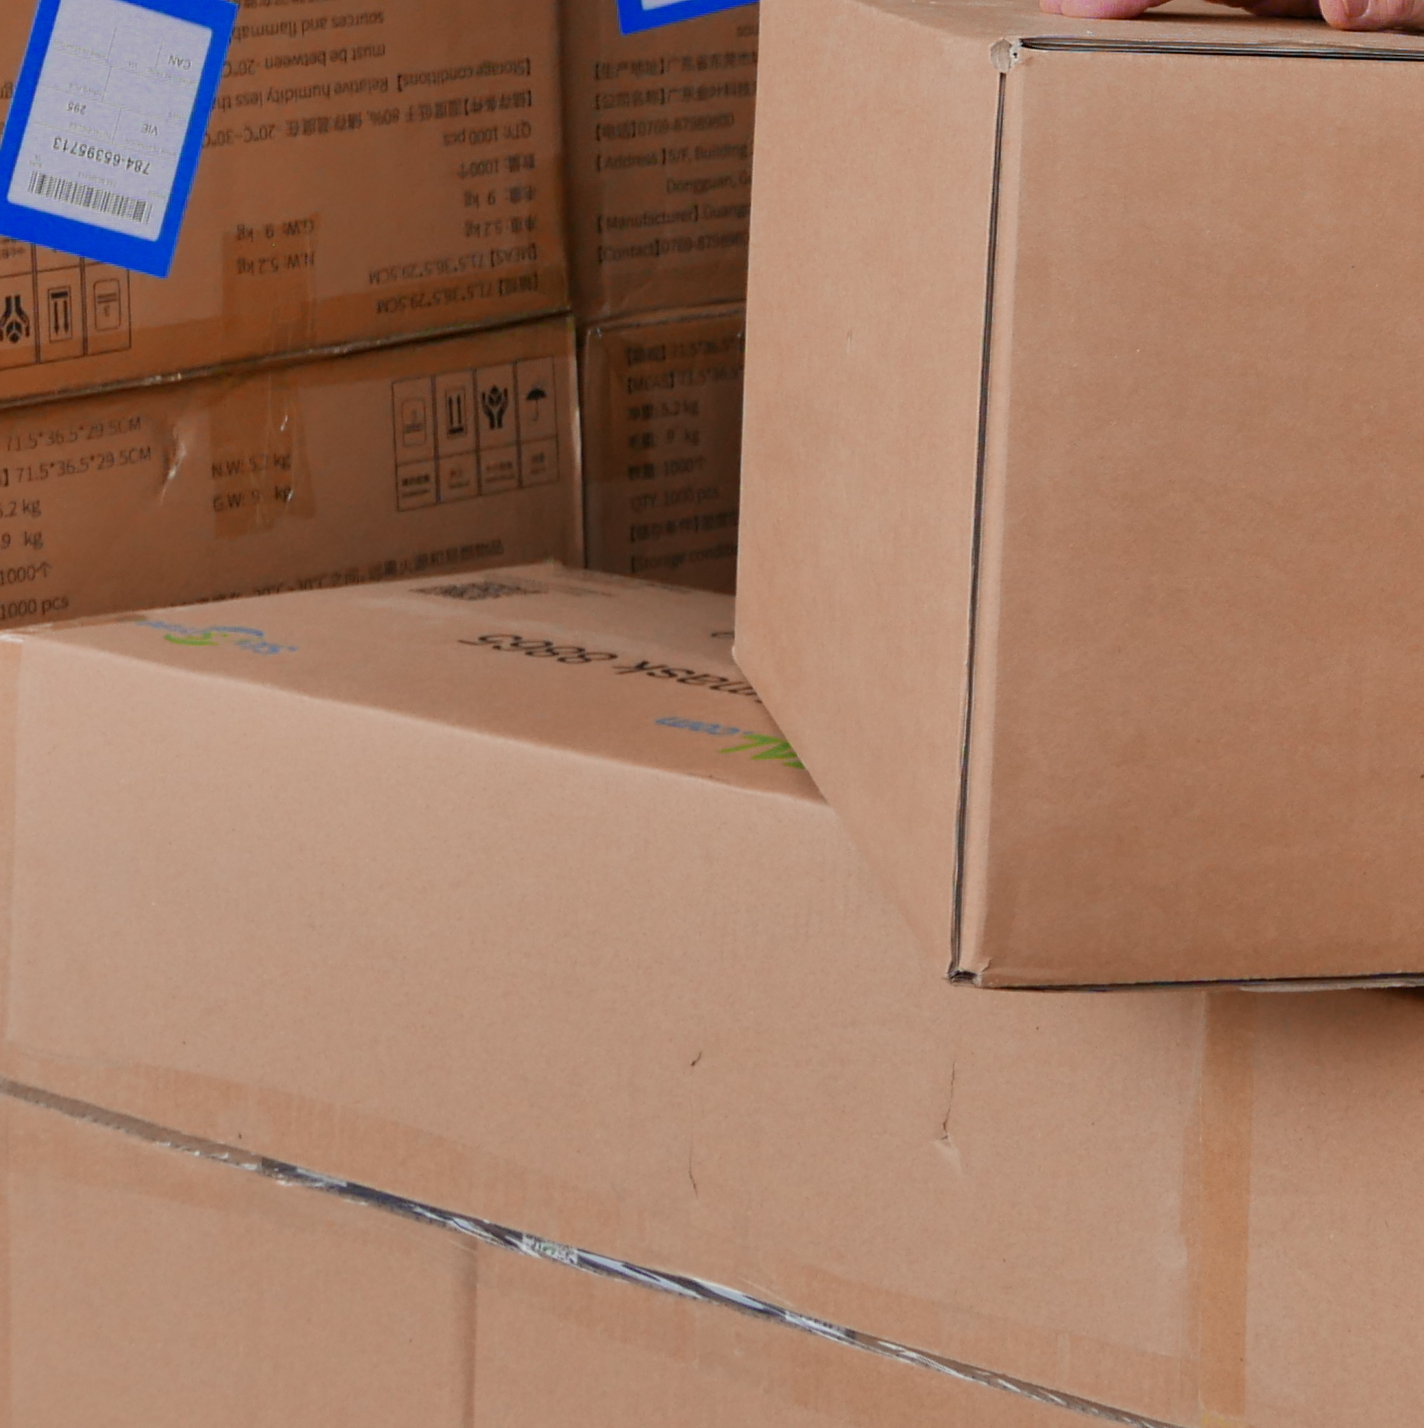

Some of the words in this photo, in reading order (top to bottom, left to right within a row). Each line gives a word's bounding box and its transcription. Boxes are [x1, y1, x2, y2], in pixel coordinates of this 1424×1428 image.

[299, 17, 328, 33] and
[331, 11, 384, 28] sources
[265, 51, 326, 69] between
[328, 48, 347, 64] be
[351, 44, 385, 61] must
[168, 54, 192, 70] CAN
[266, 84, 331, 104] humidity
[338, 77, 388, 95] Relative
[234, 92, 263, 107] less
[52, 136, 151, 175] 784-65395713
[464, 191, 482, 209] kg
[487, 190, 496, 205] 9
[236, 224, 254, 242] kg
[264, 224, 274, 240] 9
[237, 258, 255, 274] kg
[258, 256, 280, 274] 5.2
[273, 452, 291, 470] kg
[22, 500, 41, 517] kg
[24, 531, 43, 549] kg
[0, 599, 40, 621] 1000
[38, 597, 72, 617] pcs
[460, 631, 617, 666] 8865
